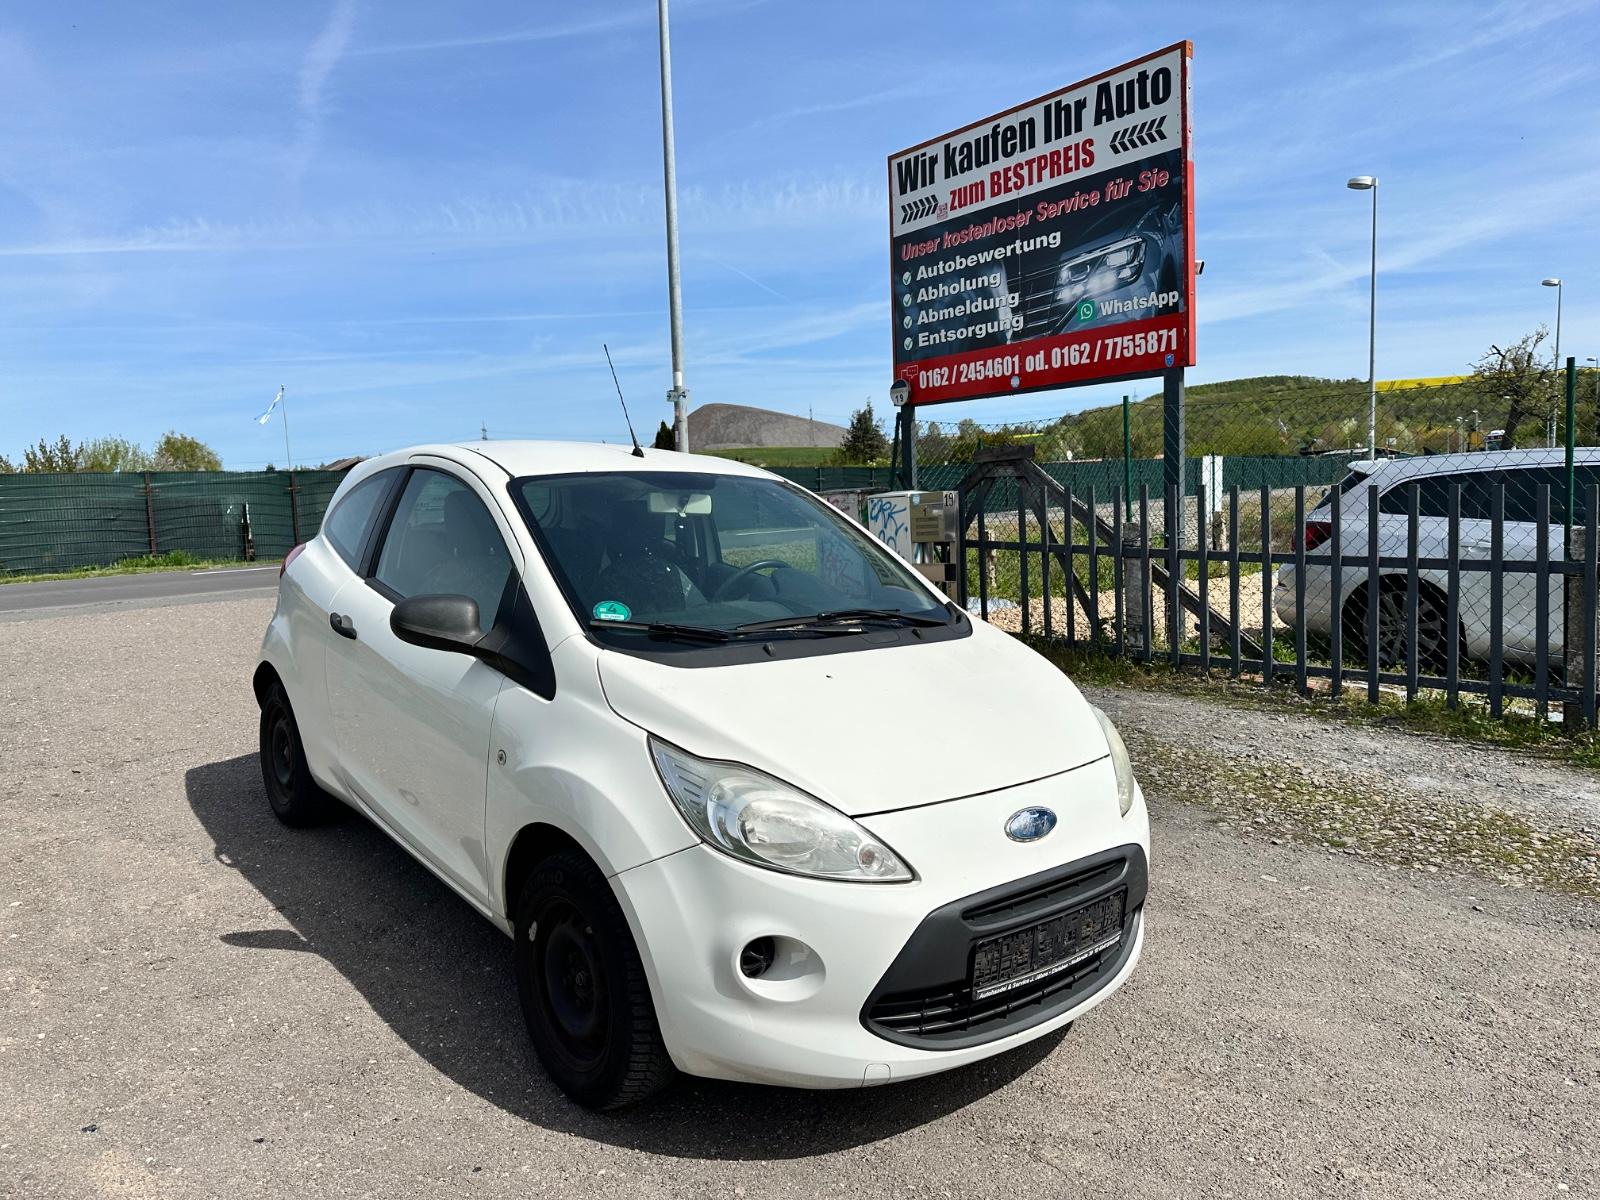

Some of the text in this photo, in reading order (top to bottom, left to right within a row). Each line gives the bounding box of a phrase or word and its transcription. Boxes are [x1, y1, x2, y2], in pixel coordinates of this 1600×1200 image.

[897, 66, 1172, 195] Wir kaufen Ihr Auto
[950, 138, 1095, 212] zum BESTPREIS
[901, 167, 1170, 261] Unser kostenloser Service für Sie
[916, 229, 1061, 281] Autobewertung
[916, 269, 1002, 304] Abholung
[1100, 288, 1179, 316] WhatsApp
[917, 291, 1020, 326] Abmeldung
[918, 313, 1024, 347] Entsorgung
[919, 327, 1178, 389] 0162 / 2454601 od. 0162 / 7755871
[943, 492, 954, 507] 19
[607, 603, 617, 614] 4
